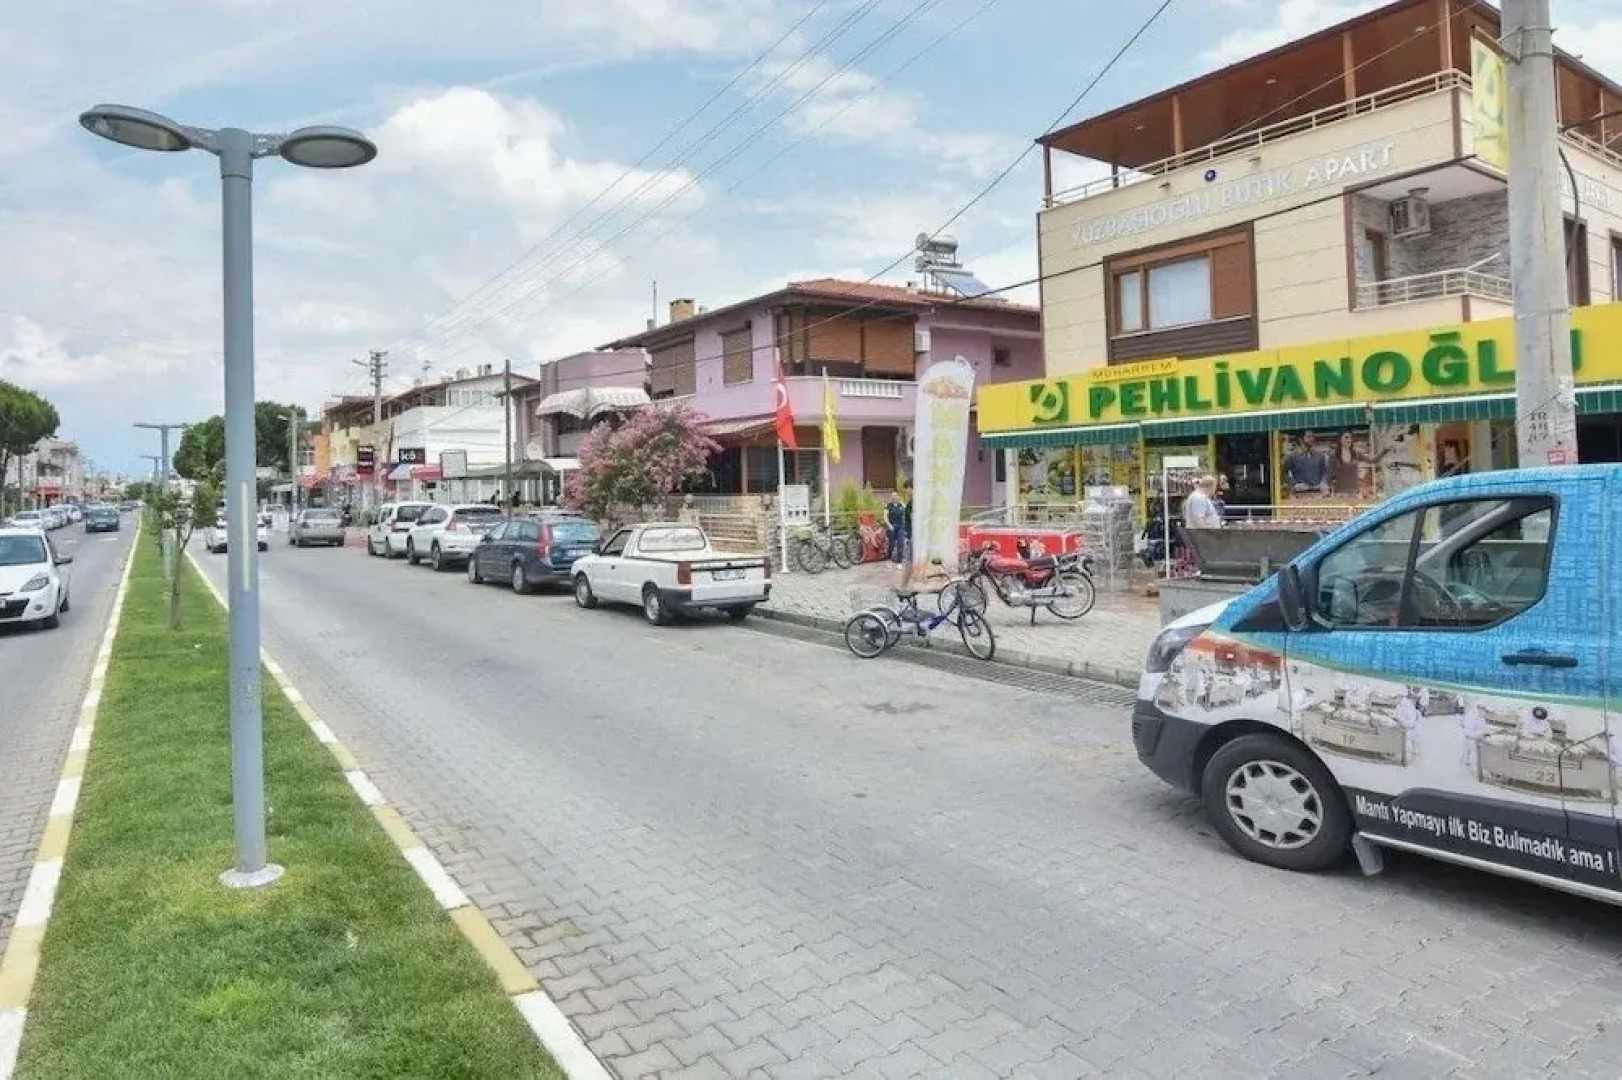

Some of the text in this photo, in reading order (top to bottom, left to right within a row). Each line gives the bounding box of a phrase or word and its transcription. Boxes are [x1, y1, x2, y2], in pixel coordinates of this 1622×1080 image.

[1304, 142, 1396, 187] APART
[1391, 807, 1447, 836] Yapmayı
[1468, 821, 1492, 844] Biz
[1494, 826, 1566, 863] Bulmadık
[1569, 850, 1605, 872] ama
